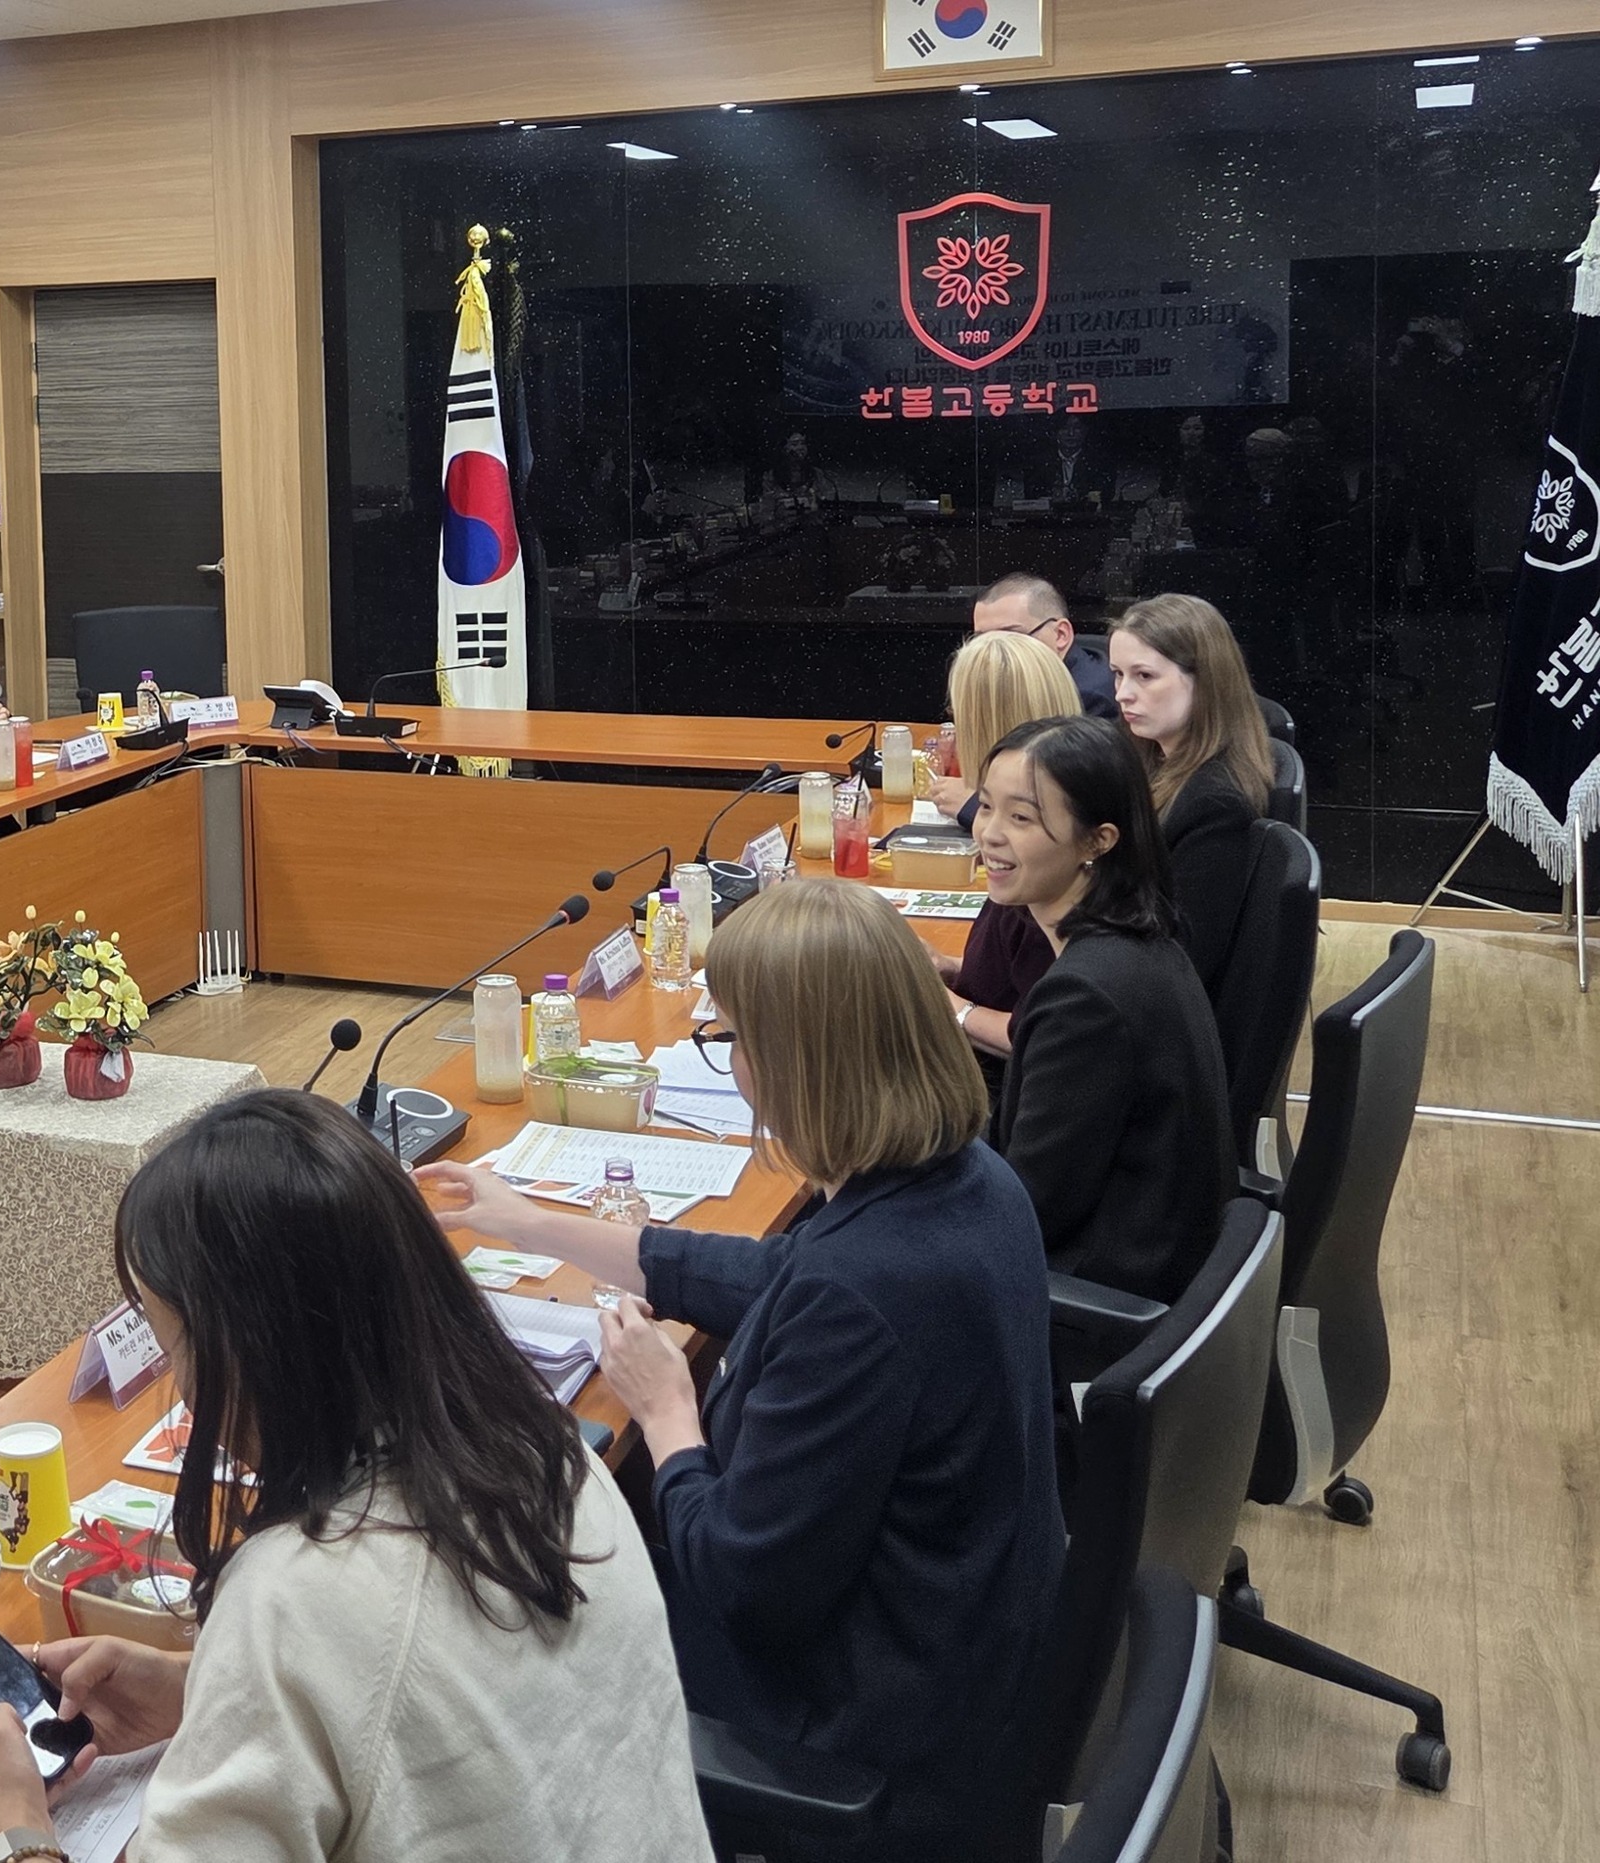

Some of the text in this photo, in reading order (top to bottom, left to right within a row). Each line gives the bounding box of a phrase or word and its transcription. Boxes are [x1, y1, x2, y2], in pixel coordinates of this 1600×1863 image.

[957, 330, 990, 344] 1980
[859, 382, 1100, 419] 한봄고등학교
[1565, 528, 1589, 552] 1980
[105, 1329, 126, 1349] Ms.
